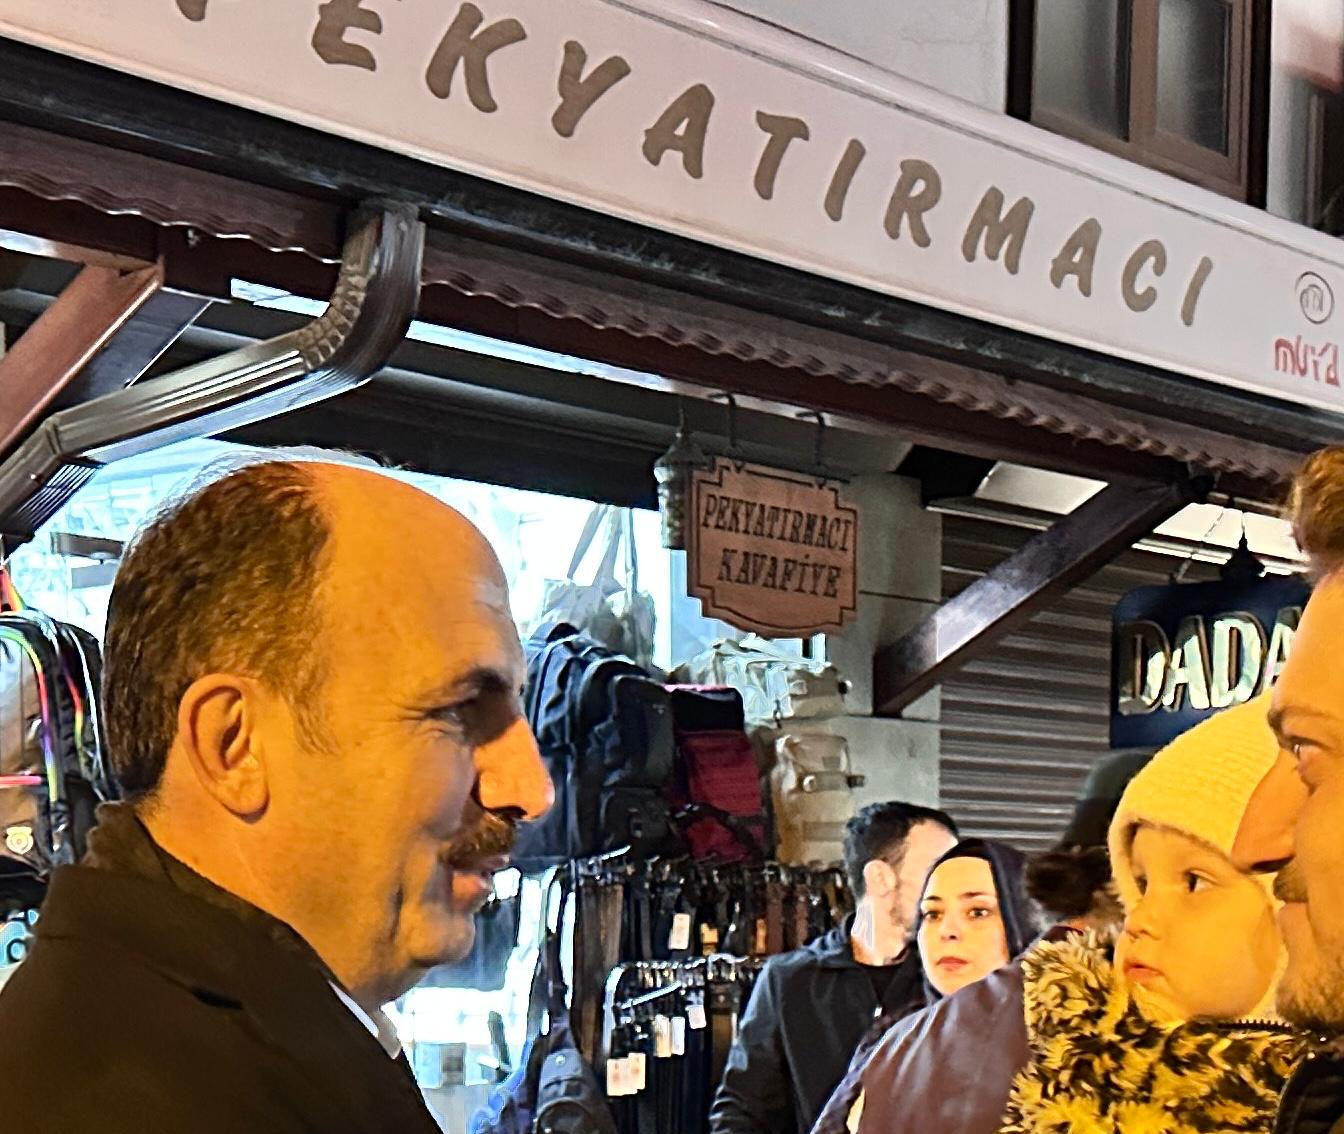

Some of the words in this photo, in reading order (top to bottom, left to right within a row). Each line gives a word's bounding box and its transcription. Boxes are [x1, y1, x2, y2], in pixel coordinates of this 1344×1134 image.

[175, 0, 1212, 326] EKYATIRMACI
[702, 493, 855, 553] PEKYATIRMACI
[717, 547, 842, 599] KAVAFİYE
